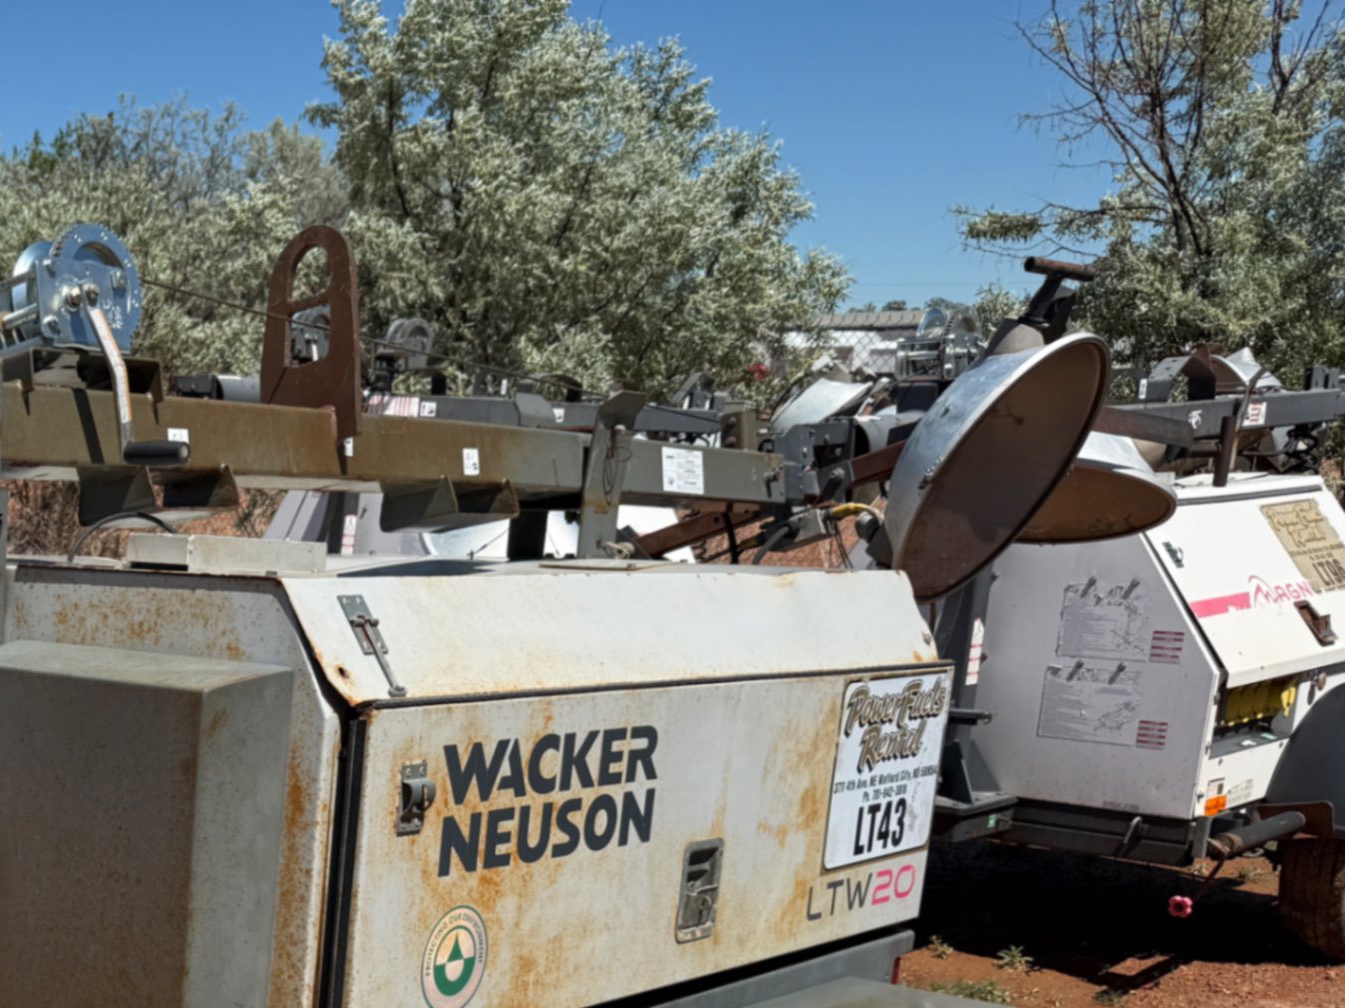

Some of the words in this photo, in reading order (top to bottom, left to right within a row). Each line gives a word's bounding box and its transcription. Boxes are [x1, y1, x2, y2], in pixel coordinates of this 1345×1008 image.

[1249, 575, 1314, 608] MAGN
[443, 725, 659, 806] WACKER
[857, 719, 926, 774] Rental
[438, 787, 657, 878] NEUSON
[853, 797, 907, 856] LT43
[807, 864, 916, 922] LTW20
